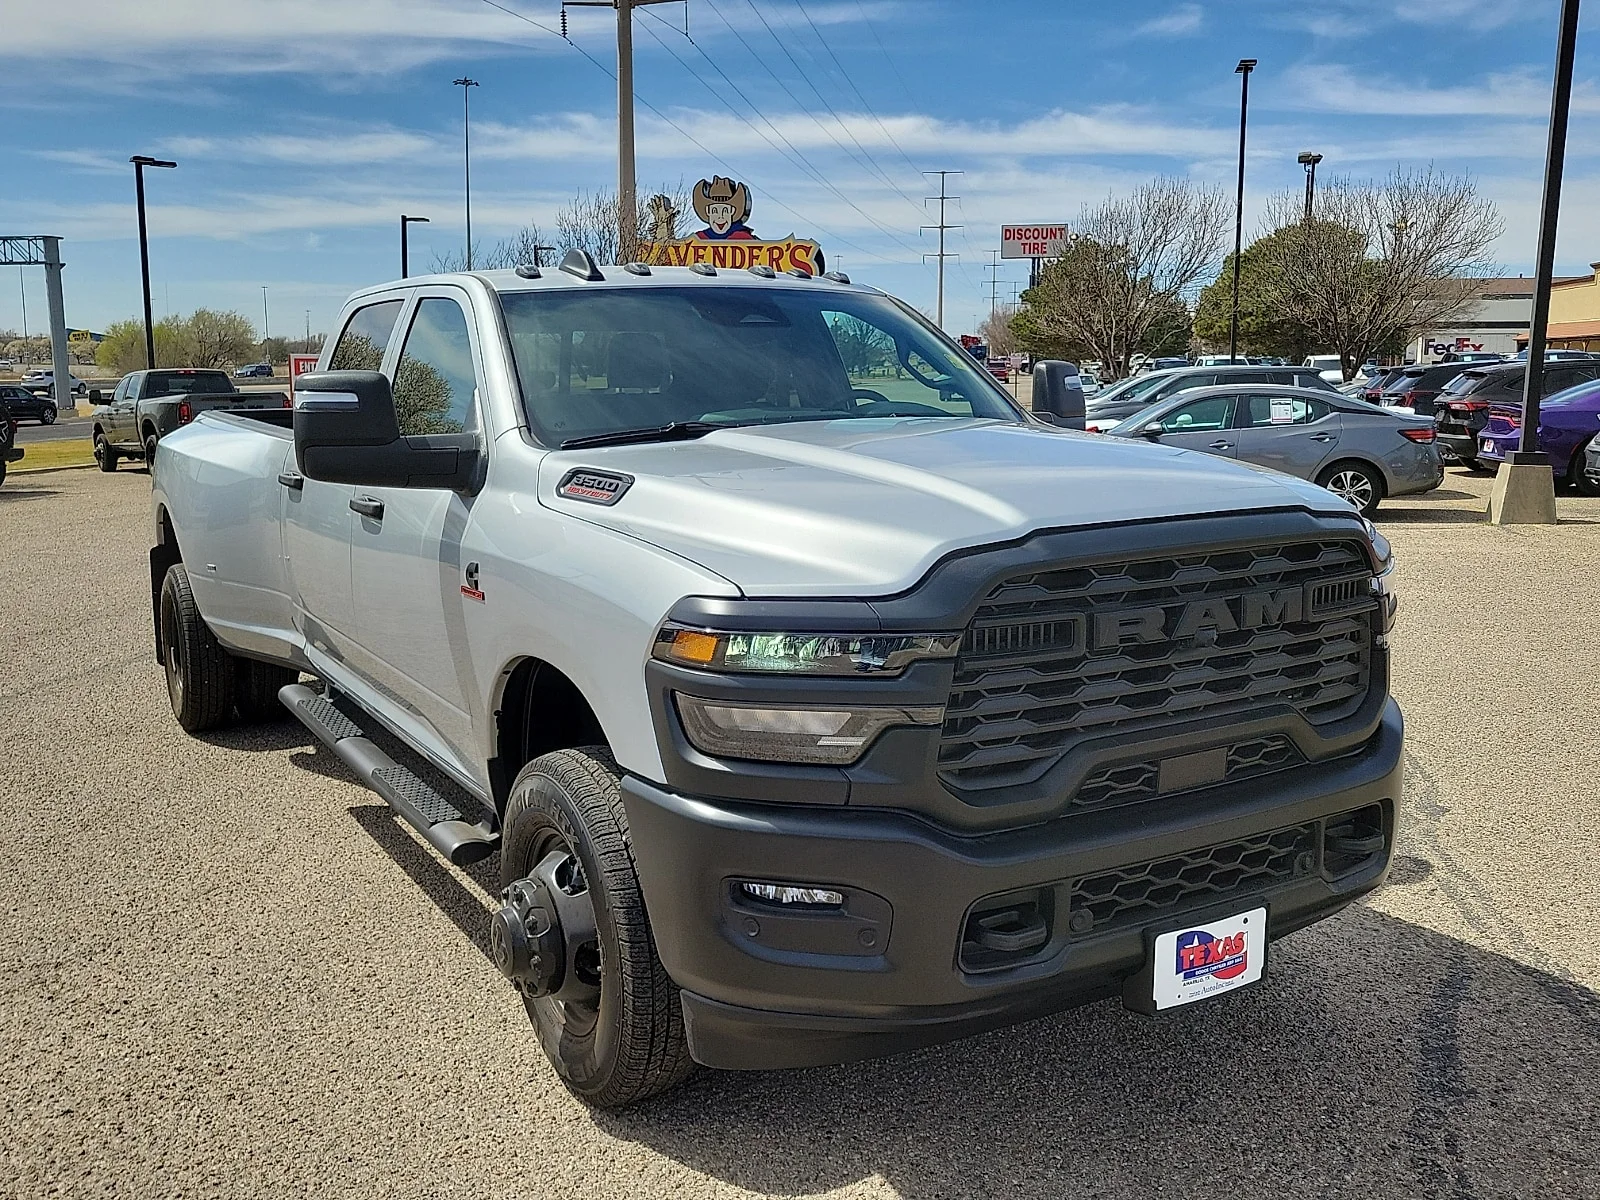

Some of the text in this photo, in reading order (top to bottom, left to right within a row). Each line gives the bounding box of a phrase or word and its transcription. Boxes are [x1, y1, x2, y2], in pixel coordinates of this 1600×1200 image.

[1004, 227, 1065, 241] DISCOUNT
[1021, 242, 1047, 255] TIRE
[573, 474, 618, 492] 3500
[1093, 586, 1303, 651] RAM
[1180, 931, 1245, 970] TEXAS
